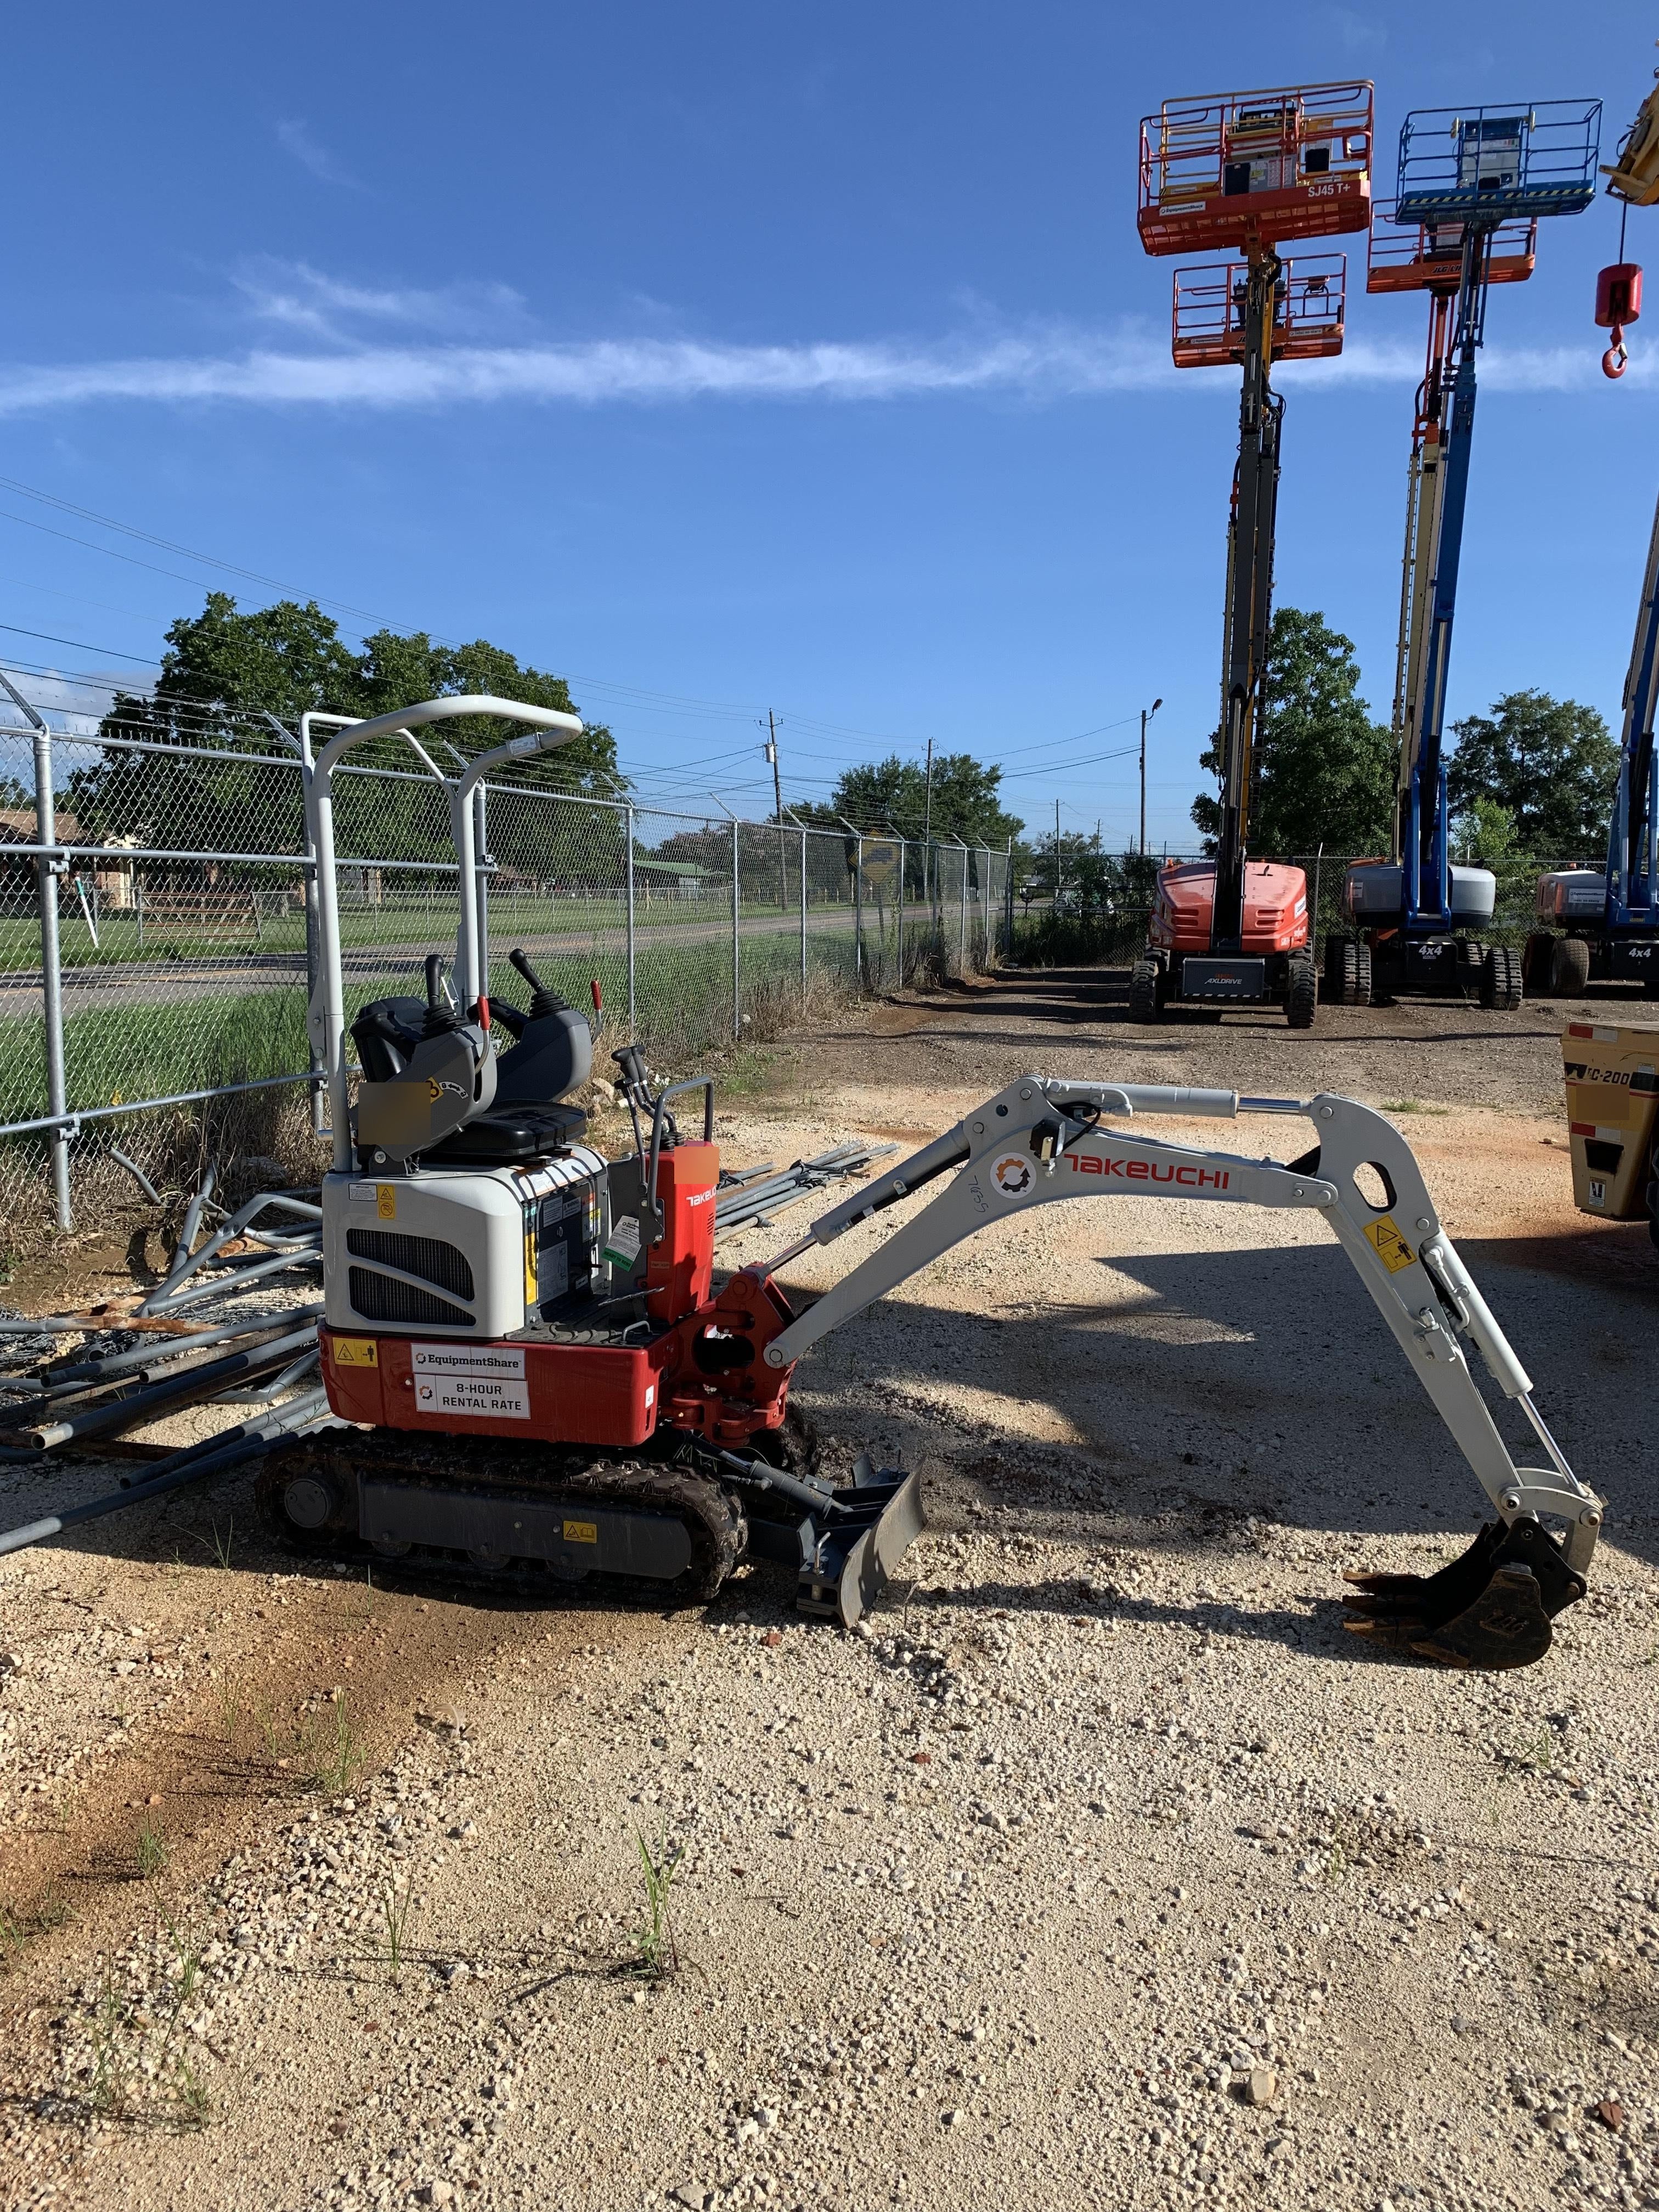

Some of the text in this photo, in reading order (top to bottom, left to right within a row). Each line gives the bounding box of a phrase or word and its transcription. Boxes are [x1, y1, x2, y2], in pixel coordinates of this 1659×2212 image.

[1308, 183, 1351, 198] SJ45 T+
[1418, 945, 1442, 955] 4x4
[1629, 948, 1651, 957] 4x4
[1064, 1153, 1229, 1189] TAKEUCHI
[428, 1354, 519, 1368] EquipmentShare
[456, 1384, 501, 1395] 8-HOUR
[442, 1397, 521, 1410] RENTAL RATE
